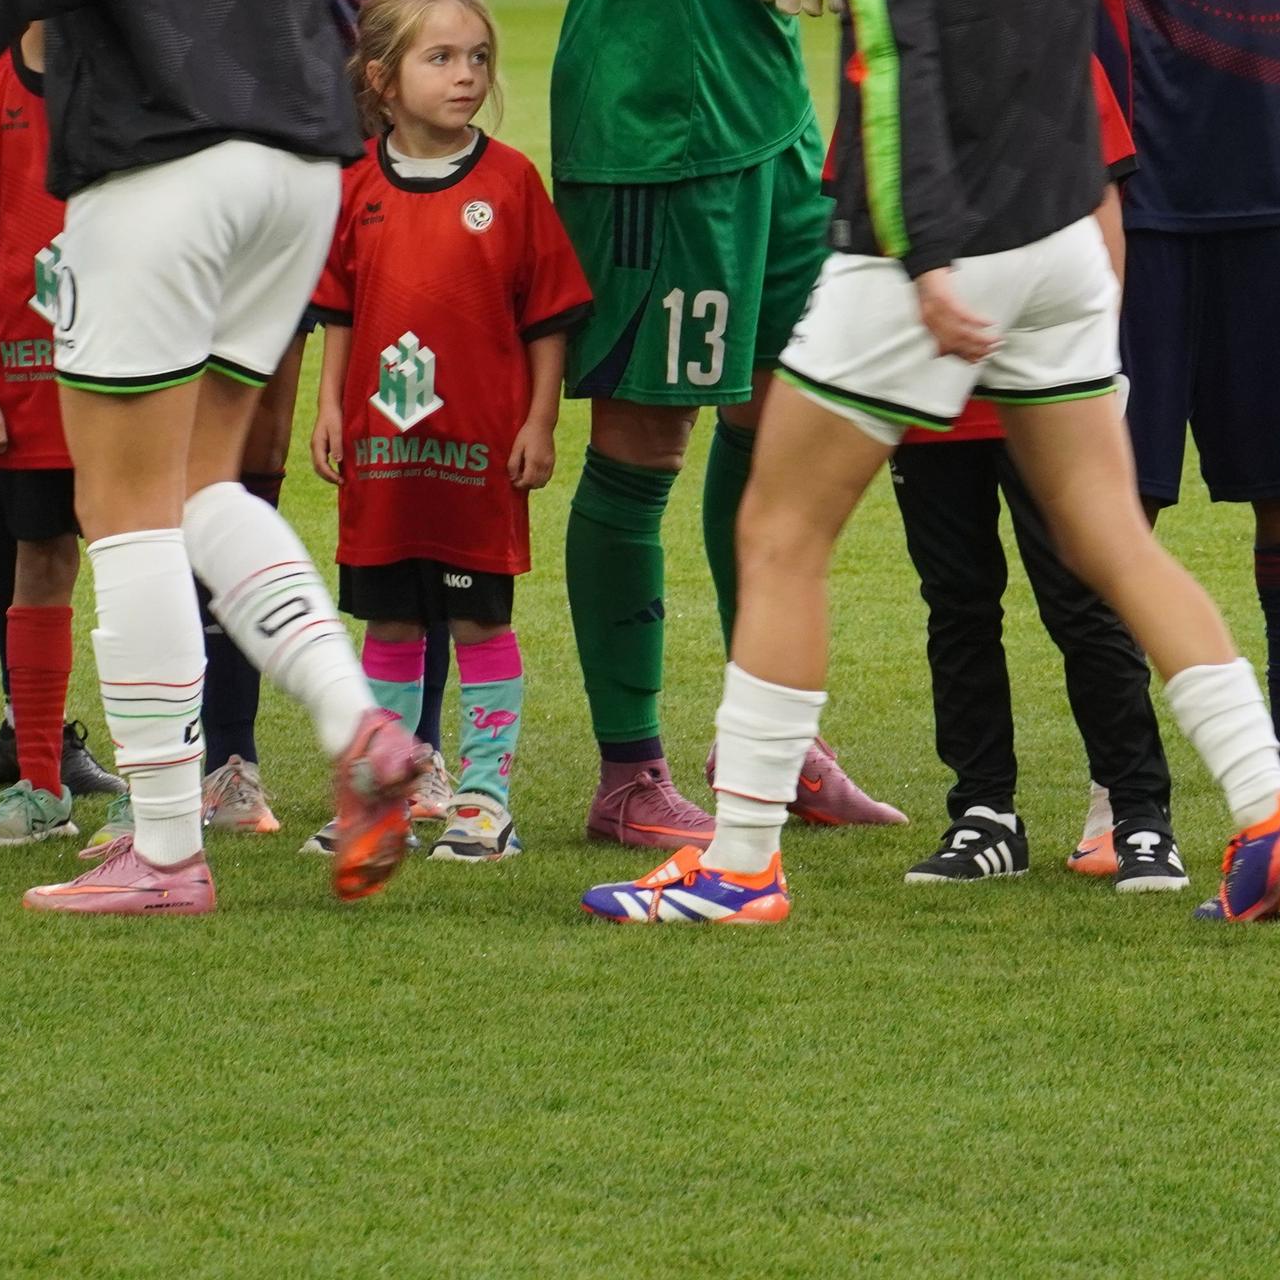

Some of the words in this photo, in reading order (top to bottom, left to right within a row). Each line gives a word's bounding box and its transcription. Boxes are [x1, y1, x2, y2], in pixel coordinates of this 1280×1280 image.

[662, 287, 730, 386] 13
[354, 435, 490, 471] HRMANS
[443, 572, 473, 589] AKO
